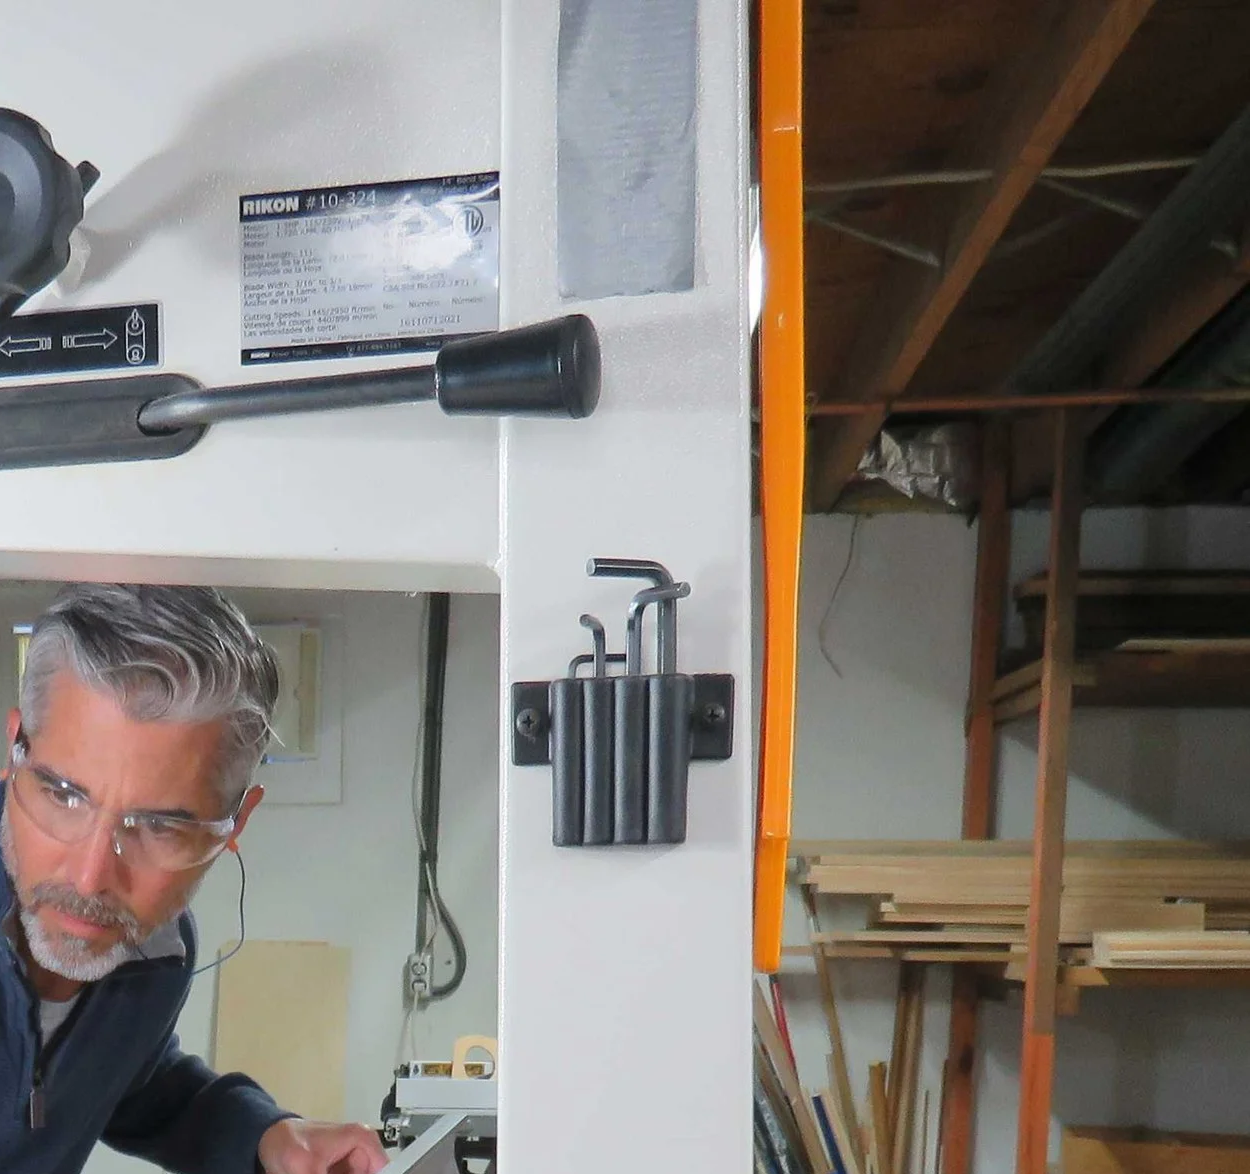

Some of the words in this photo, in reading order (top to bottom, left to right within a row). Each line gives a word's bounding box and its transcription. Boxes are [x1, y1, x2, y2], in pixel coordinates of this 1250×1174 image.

[243, 196, 299, 216] RIKON
[244, 314, 272, 322] Cutting
[244, 329, 256, 337] Las
